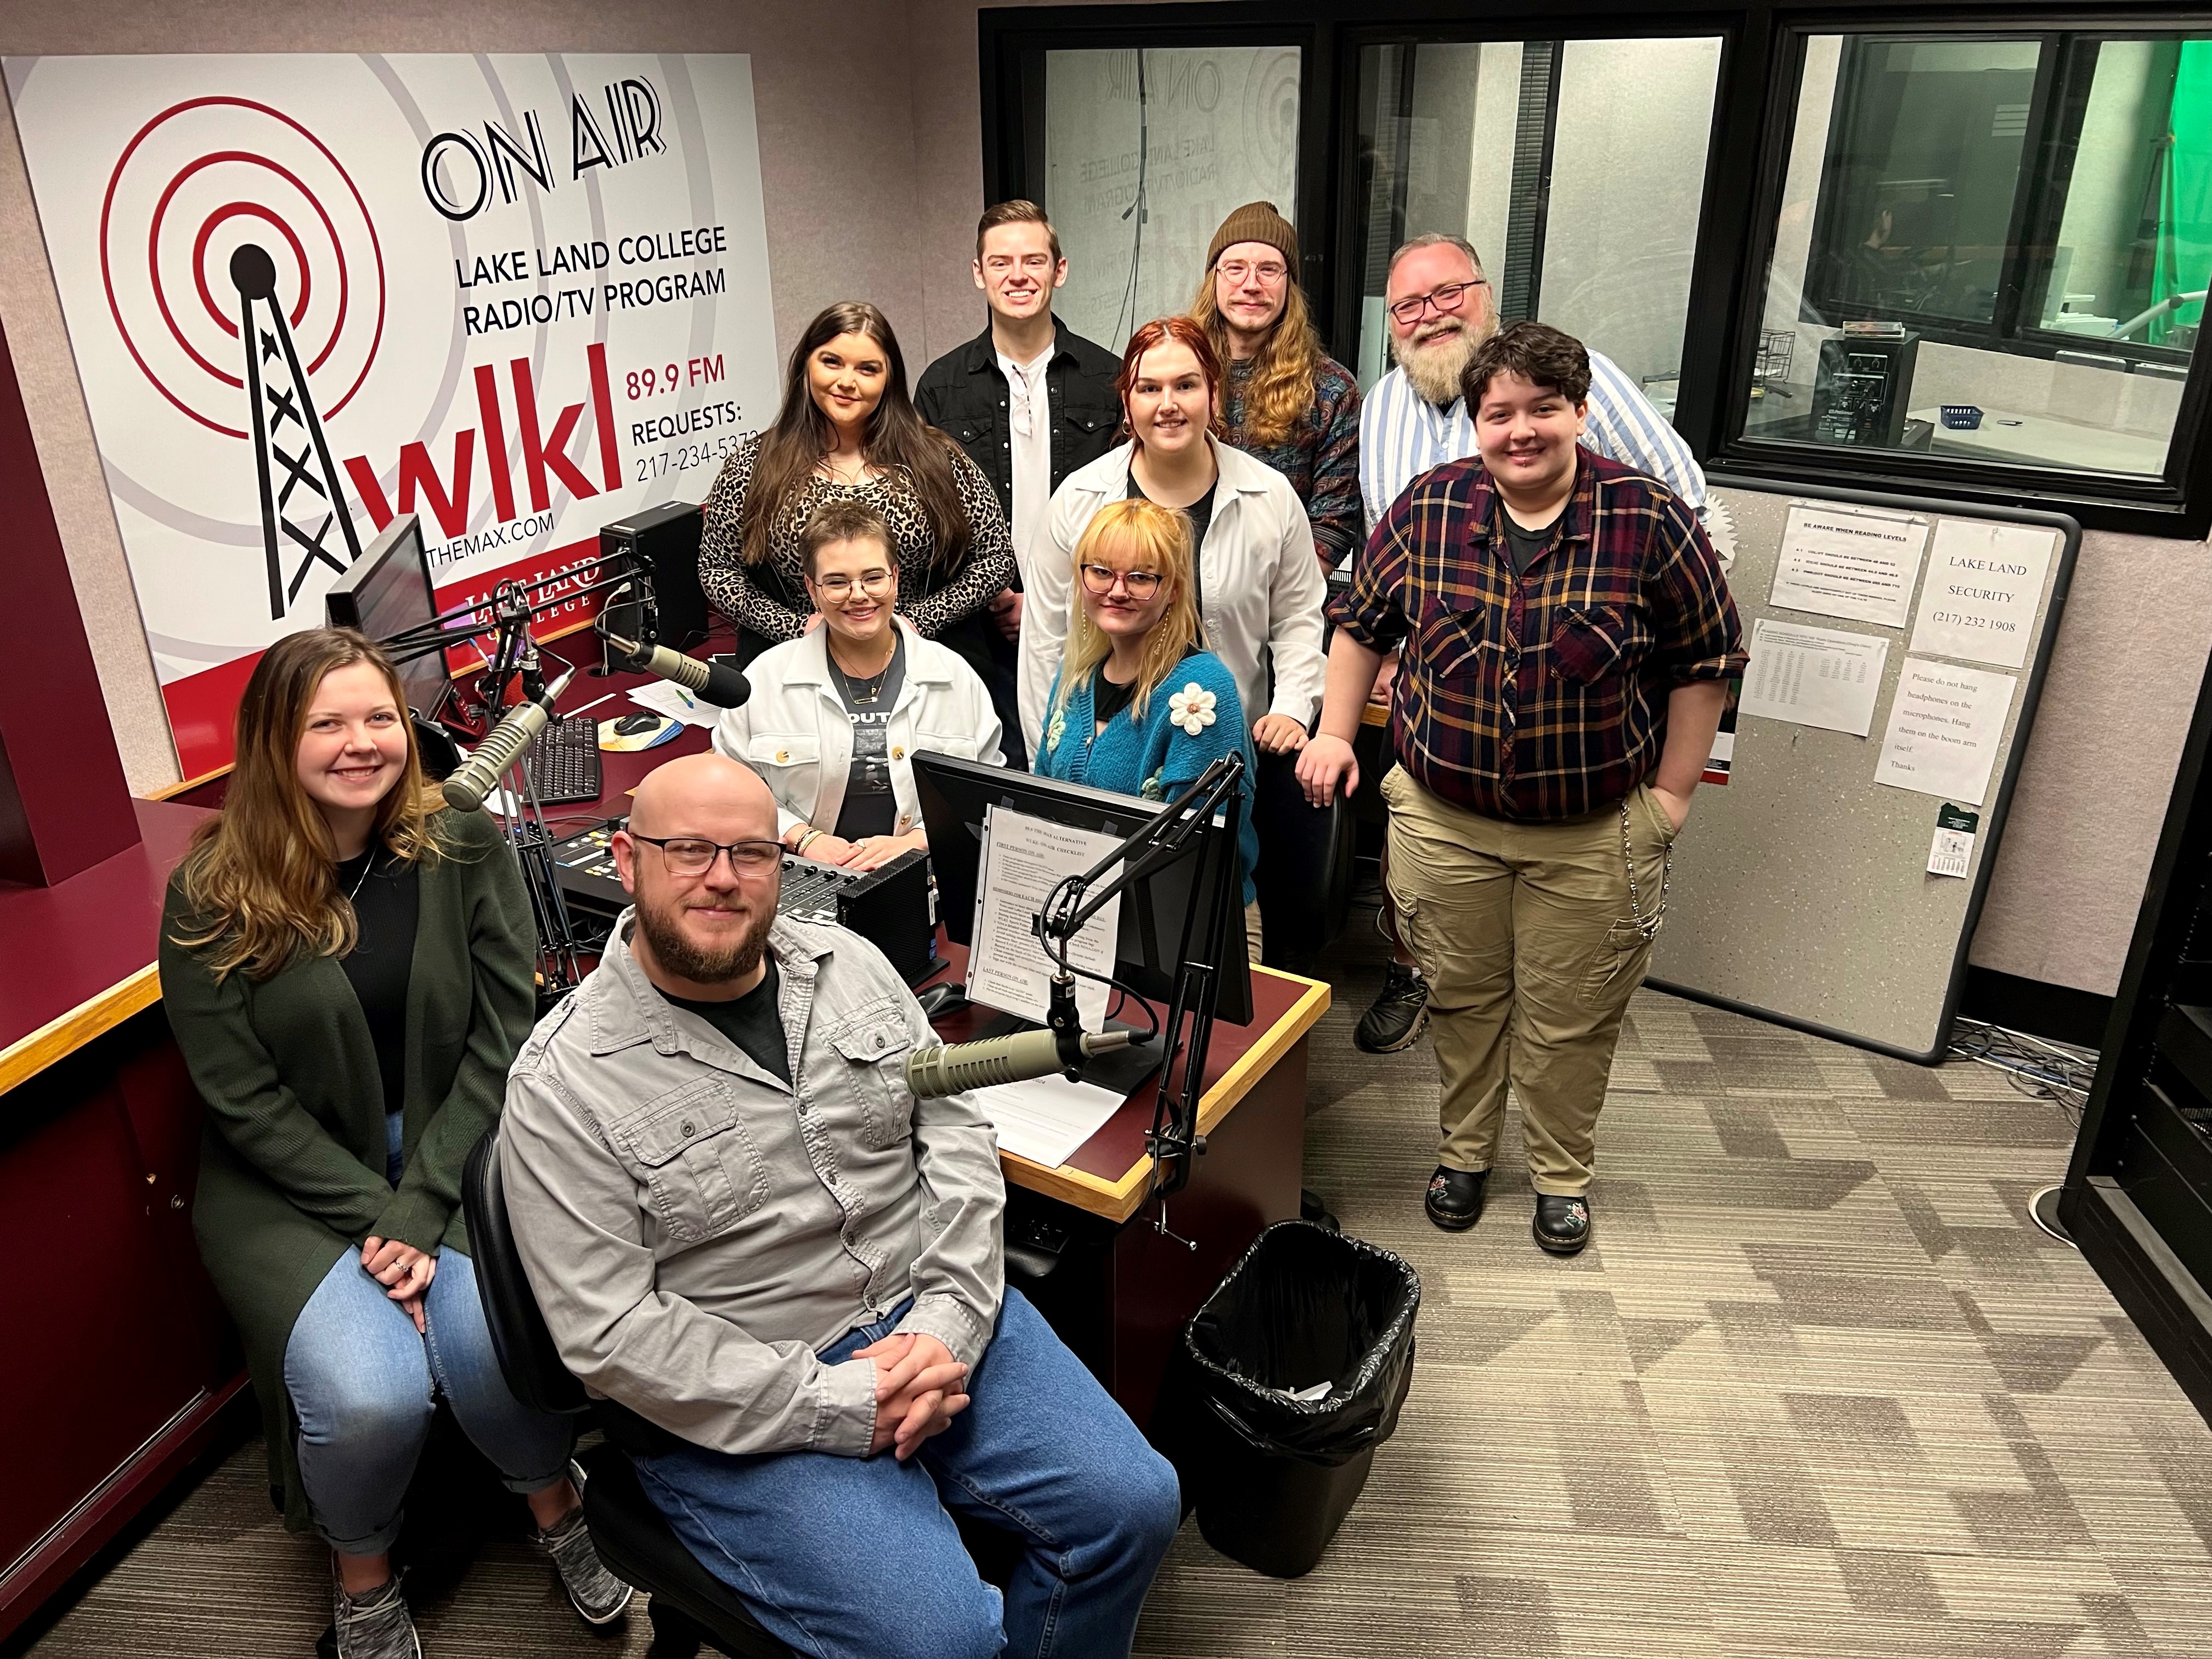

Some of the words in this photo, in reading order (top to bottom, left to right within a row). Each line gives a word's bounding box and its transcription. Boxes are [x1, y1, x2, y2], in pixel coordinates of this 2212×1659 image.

[421, 109, 555, 222] ON
[572, 76, 667, 181] AIR
[455, 251, 529, 288] LAKE
[537, 241, 610, 277] LAND
[618, 226, 727, 265] COLLEGE
[464, 287, 595, 336] RADIO/TV
[604, 268, 726, 312] PROGRAM
[627, 364, 679, 400] 89.9
[688, 354, 725, 387] FM
[631, 401, 742, 447] REQUESTS:
[342, 342, 623, 540] wlkl
[1949, 556, 1986, 571] LAKE
[1989, 562, 2027, 575] LAND
[534, 556, 600, 603] LAND
[1948, 585, 2015, 603] SECURITY
[1933, 611, 1962, 625] (217)
[1964, 616, 1985, 628] 232
[1989, 620, 2016, 632] 1908
[1912, 673, 1935, 684] Please
[1960, 682, 1978, 692] hang
[1907, 691, 1948, 704] headphones
[1902, 709, 1949, 724] microphones.
[1952, 718, 1971, 729] Hang
[1898, 726, 1916, 735] them
[1940, 734, 1961, 744] boom
[1894, 743, 1914, 753] itself.
[1891, 760, 1915, 771] Thanks
[1009, 845, 1027, 854] PERSON
[1053, 836, 1087, 846] ALTERNATIVE
[1057, 847, 1085, 856] CHECKLIST
[995, 969, 1012, 979] PERSON
